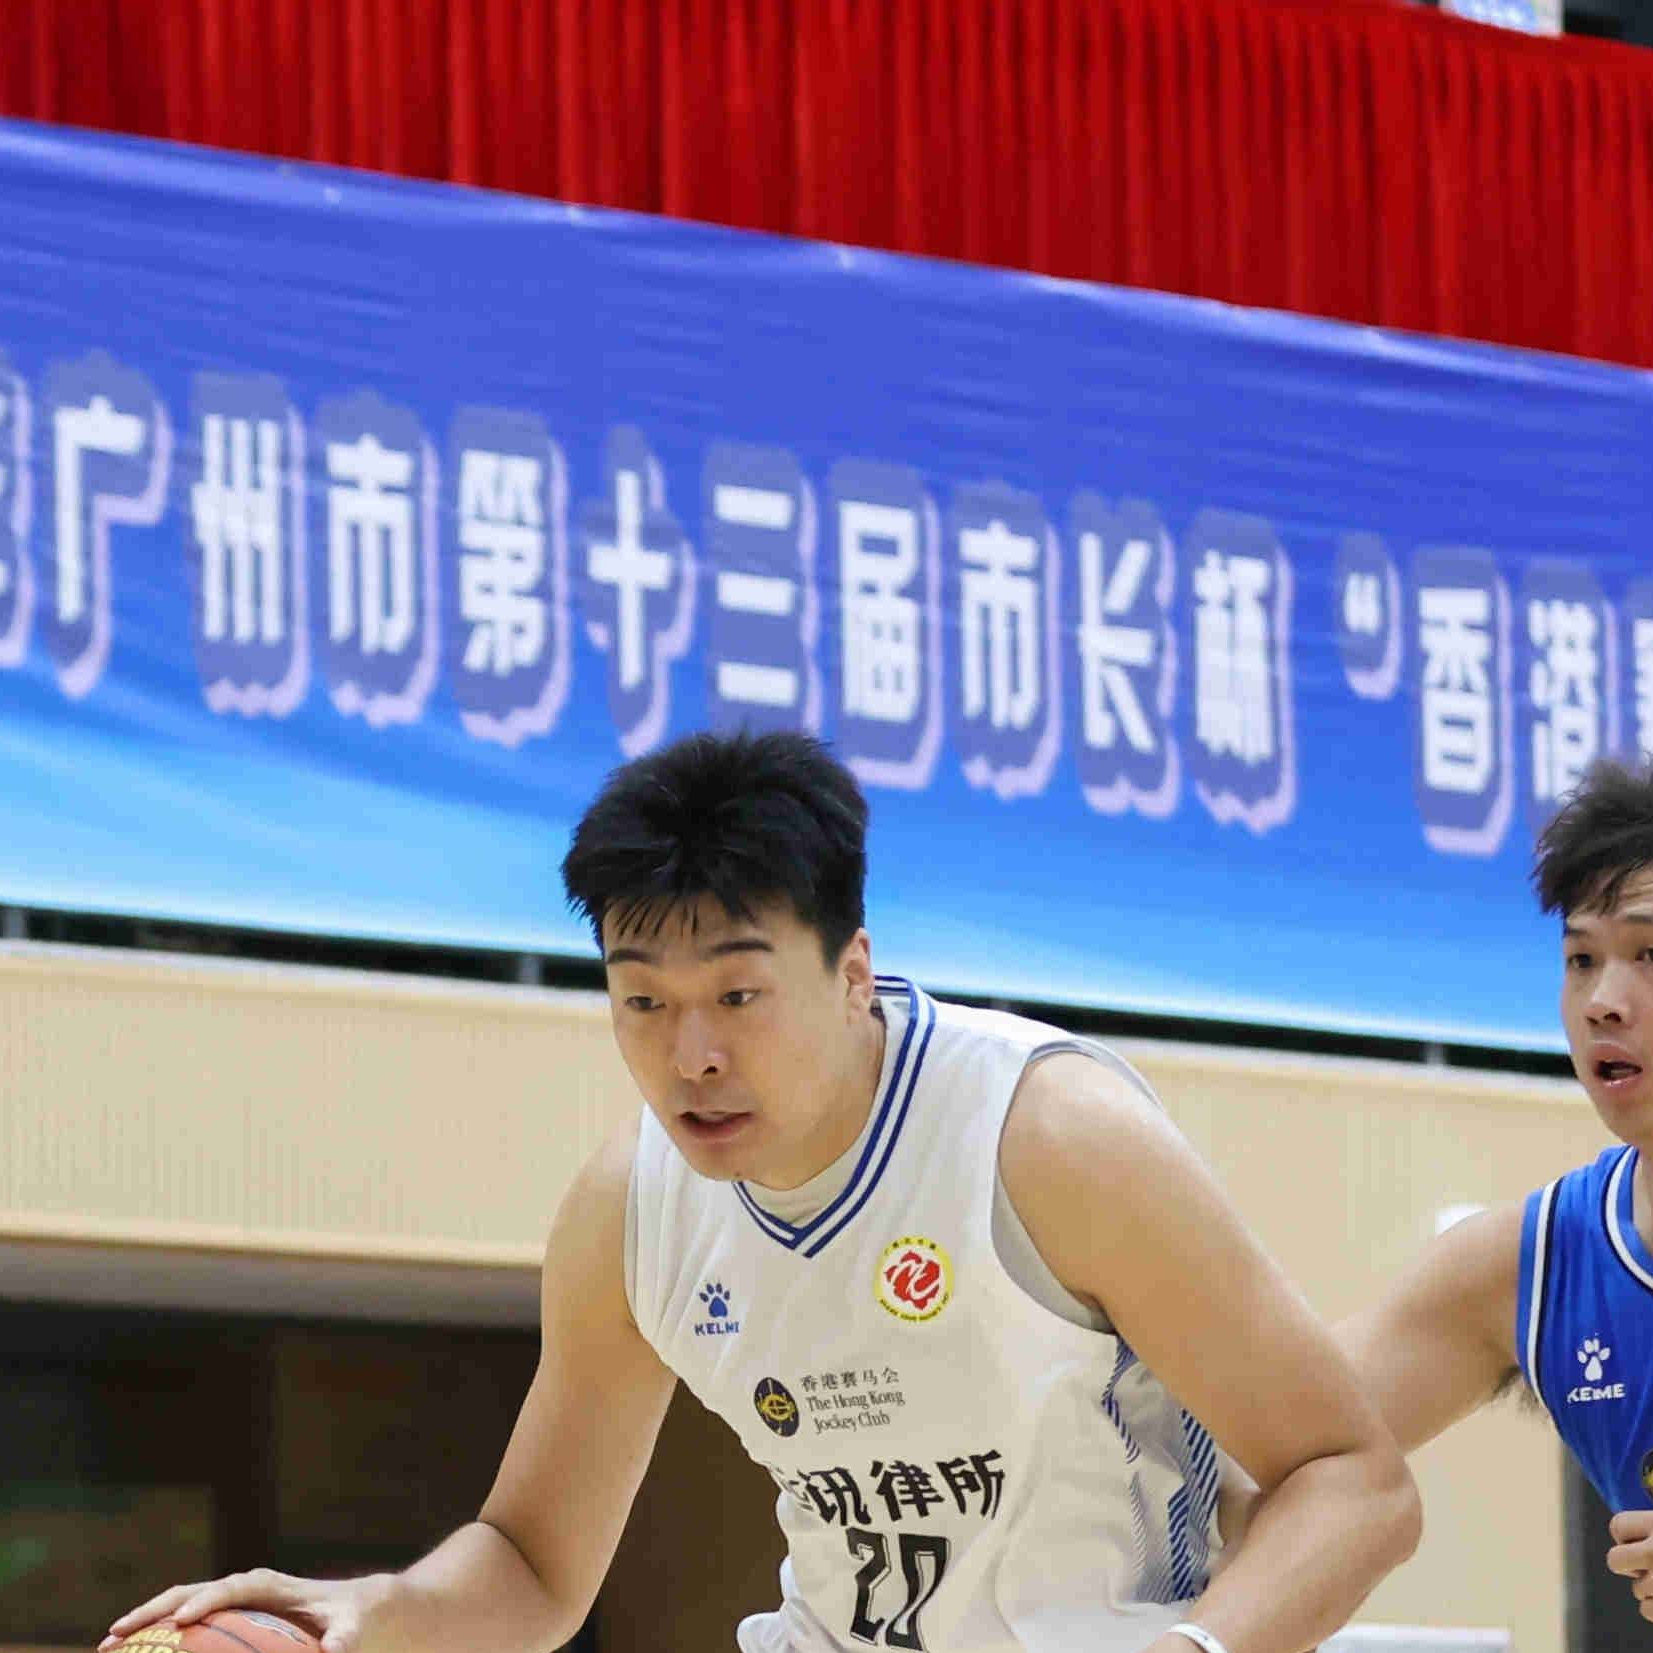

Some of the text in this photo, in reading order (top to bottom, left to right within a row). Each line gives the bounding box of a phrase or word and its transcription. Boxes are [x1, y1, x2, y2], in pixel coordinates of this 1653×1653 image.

[805, 1389, 905, 1412] The Hong Kong
[857, 1409, 891, 1428] Club
